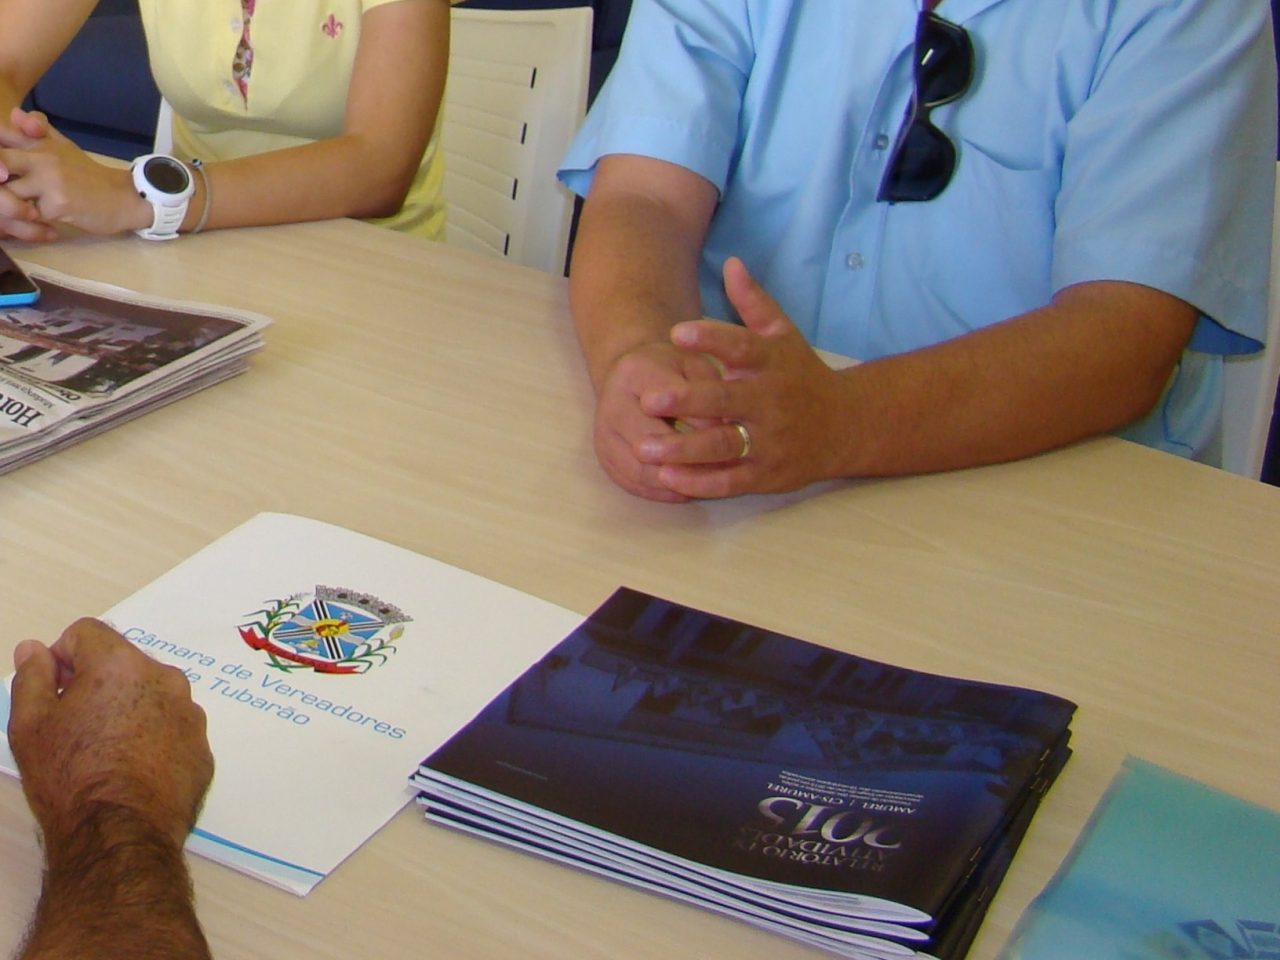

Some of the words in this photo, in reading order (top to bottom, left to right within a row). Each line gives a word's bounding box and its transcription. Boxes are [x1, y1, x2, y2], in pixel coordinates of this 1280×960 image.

[122, 626, 216, 668] Câmara
[220, 661, 253, 681] de
[258, 673, 407, 740] Vereadores
[209, 676, 310, 727] Tubarão
[757, 796, 902, 849] 2015
[862, 801, 917, 815] AMUREL
